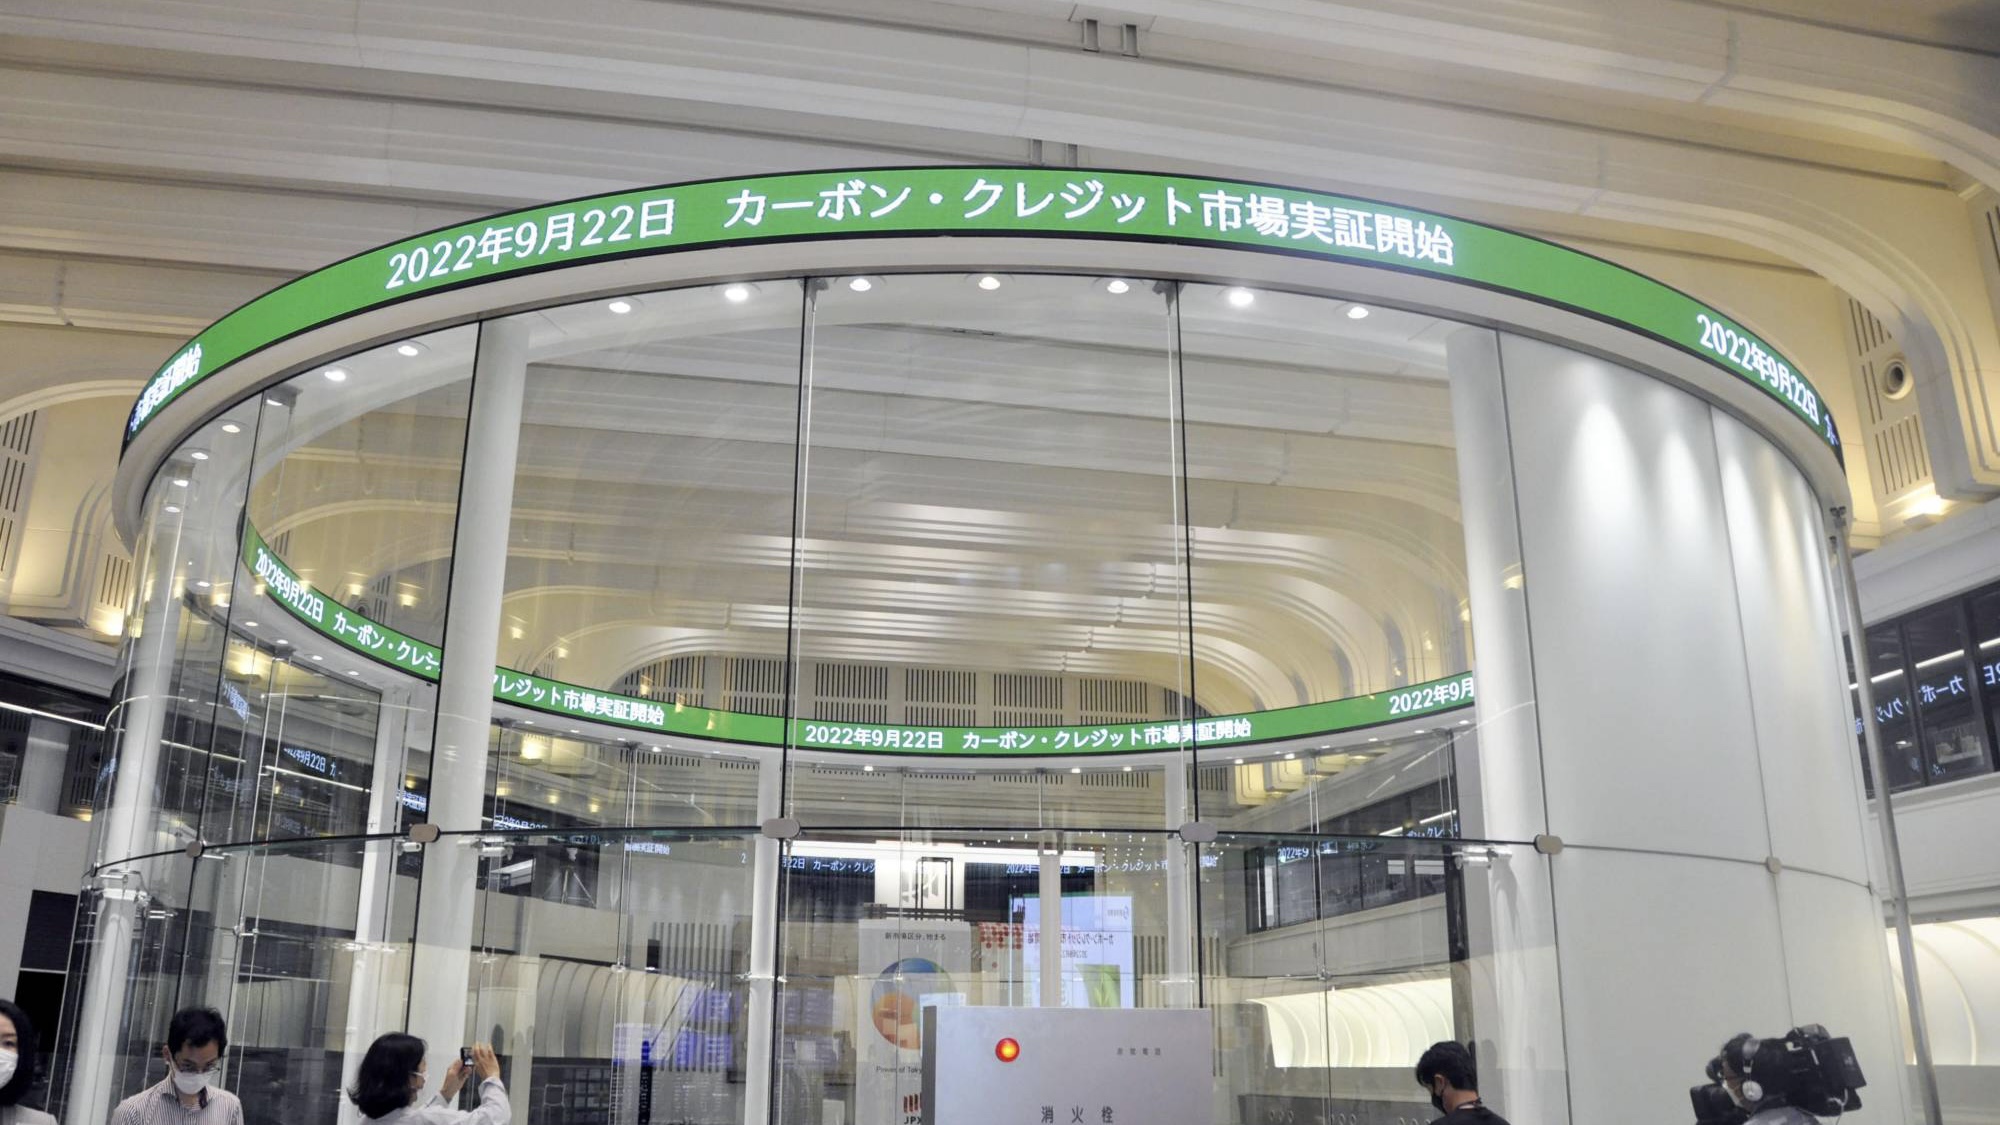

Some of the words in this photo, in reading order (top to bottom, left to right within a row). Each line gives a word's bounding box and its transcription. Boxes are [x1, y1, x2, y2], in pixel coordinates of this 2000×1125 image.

[385, 198, 675, 290] 2022年9月22日
[723, 178, 1455, 266] カーボン・クレジット市場実証開始
[1697, 314, 1820, 426] 2022年9月22日
[255, 547, 324, 623] 2022年9月22日
[804, 725, 944, 749] 2022年9月22日
[961, 718, 1252, 750] カーボン・クレジット市場実証開始
[1041, 1105, 1113, 1124] 消火栓
